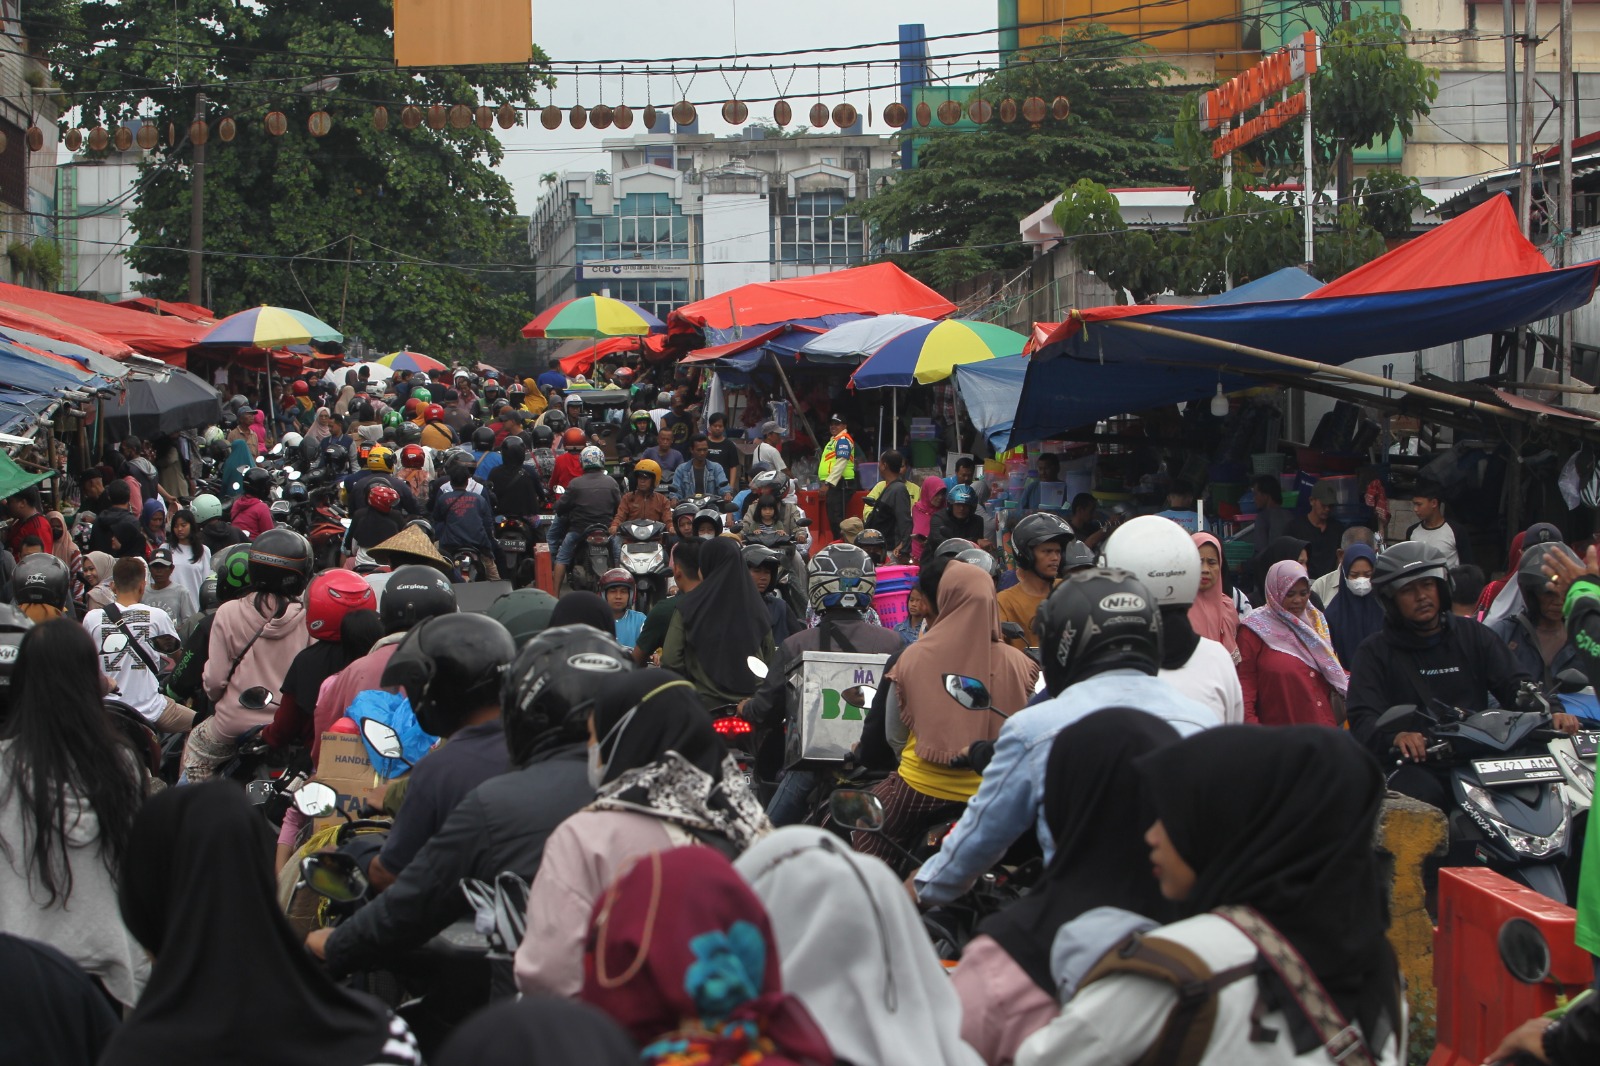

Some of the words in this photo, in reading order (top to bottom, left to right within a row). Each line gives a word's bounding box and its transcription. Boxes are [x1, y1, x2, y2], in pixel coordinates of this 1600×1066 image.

[592, 265, 611, 273] CCB
[1107, 597, 1139, 609] NHK
[853, 669, 875, 685] MA
[1479, 763, 1487, 773] F
